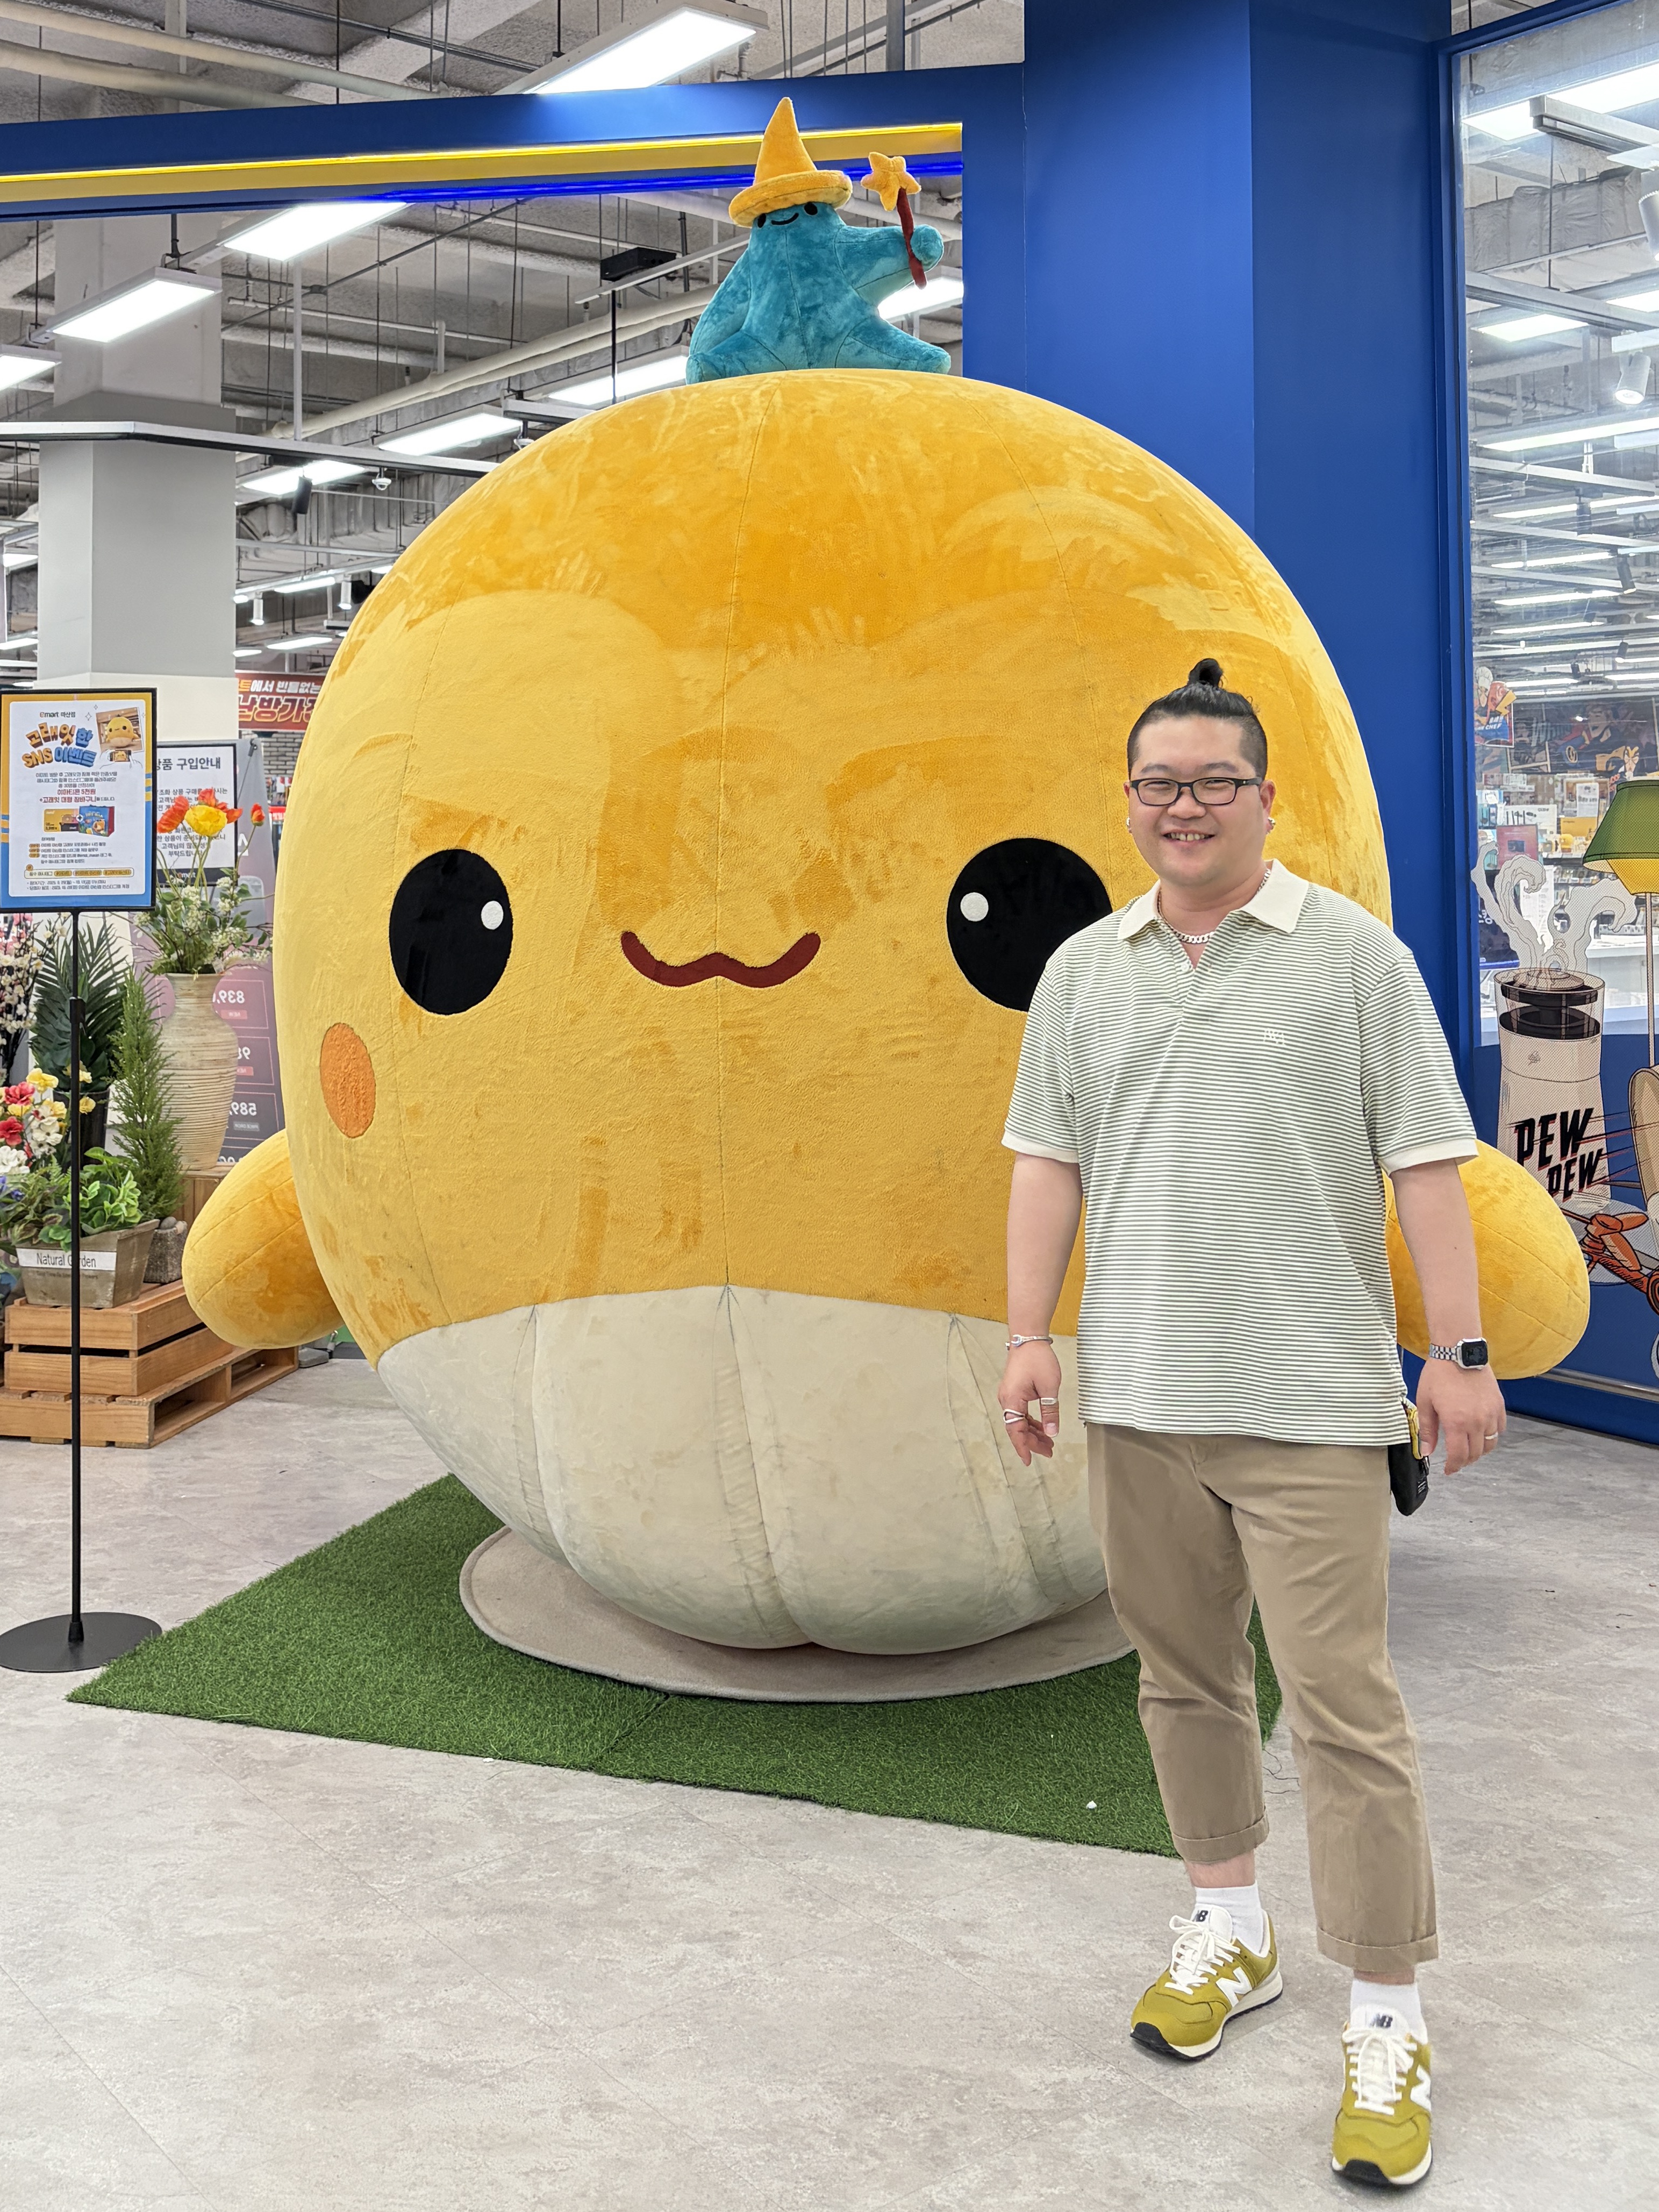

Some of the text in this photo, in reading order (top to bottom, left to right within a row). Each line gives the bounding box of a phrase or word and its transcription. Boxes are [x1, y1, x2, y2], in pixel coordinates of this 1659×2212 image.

[238, 680, 275, 693] 트에서
[22, 747, 97, 768] SNS 이벤트
[176, 757, 220, 770] 구입안내
[1514, 1108, 1594, 1171] PEW
[37, 1252, 96, 1268] Natural Gden
